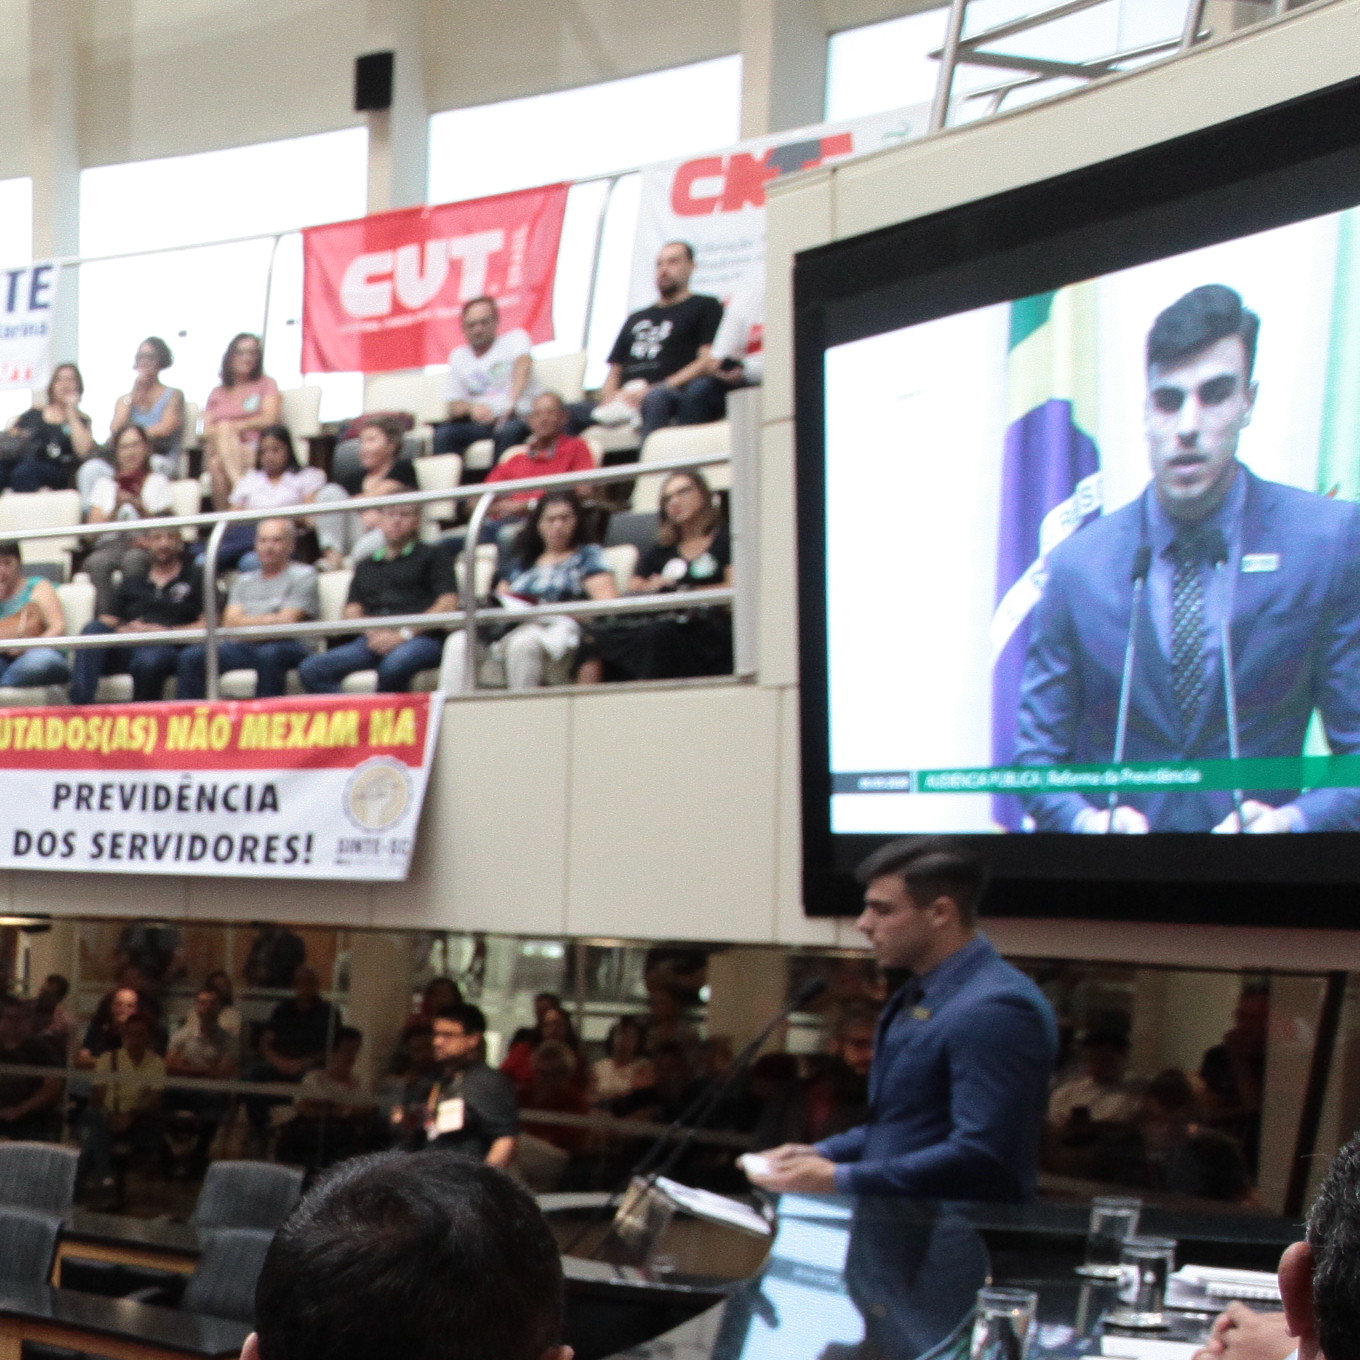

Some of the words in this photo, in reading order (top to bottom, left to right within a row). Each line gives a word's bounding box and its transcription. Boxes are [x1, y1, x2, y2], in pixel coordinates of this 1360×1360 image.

[339, 228, 505, 319] CUT
[165, 707, 232, 750] NÃO
[238, 709, 360, 749] MEXAM
[369, 707, 416, 747] NA
[53, 772, 279, 812] PREVIDÊNCIA
[13, 829, 77, 859] DOS
[89, 831, 314, 865] SERVIDORES!
